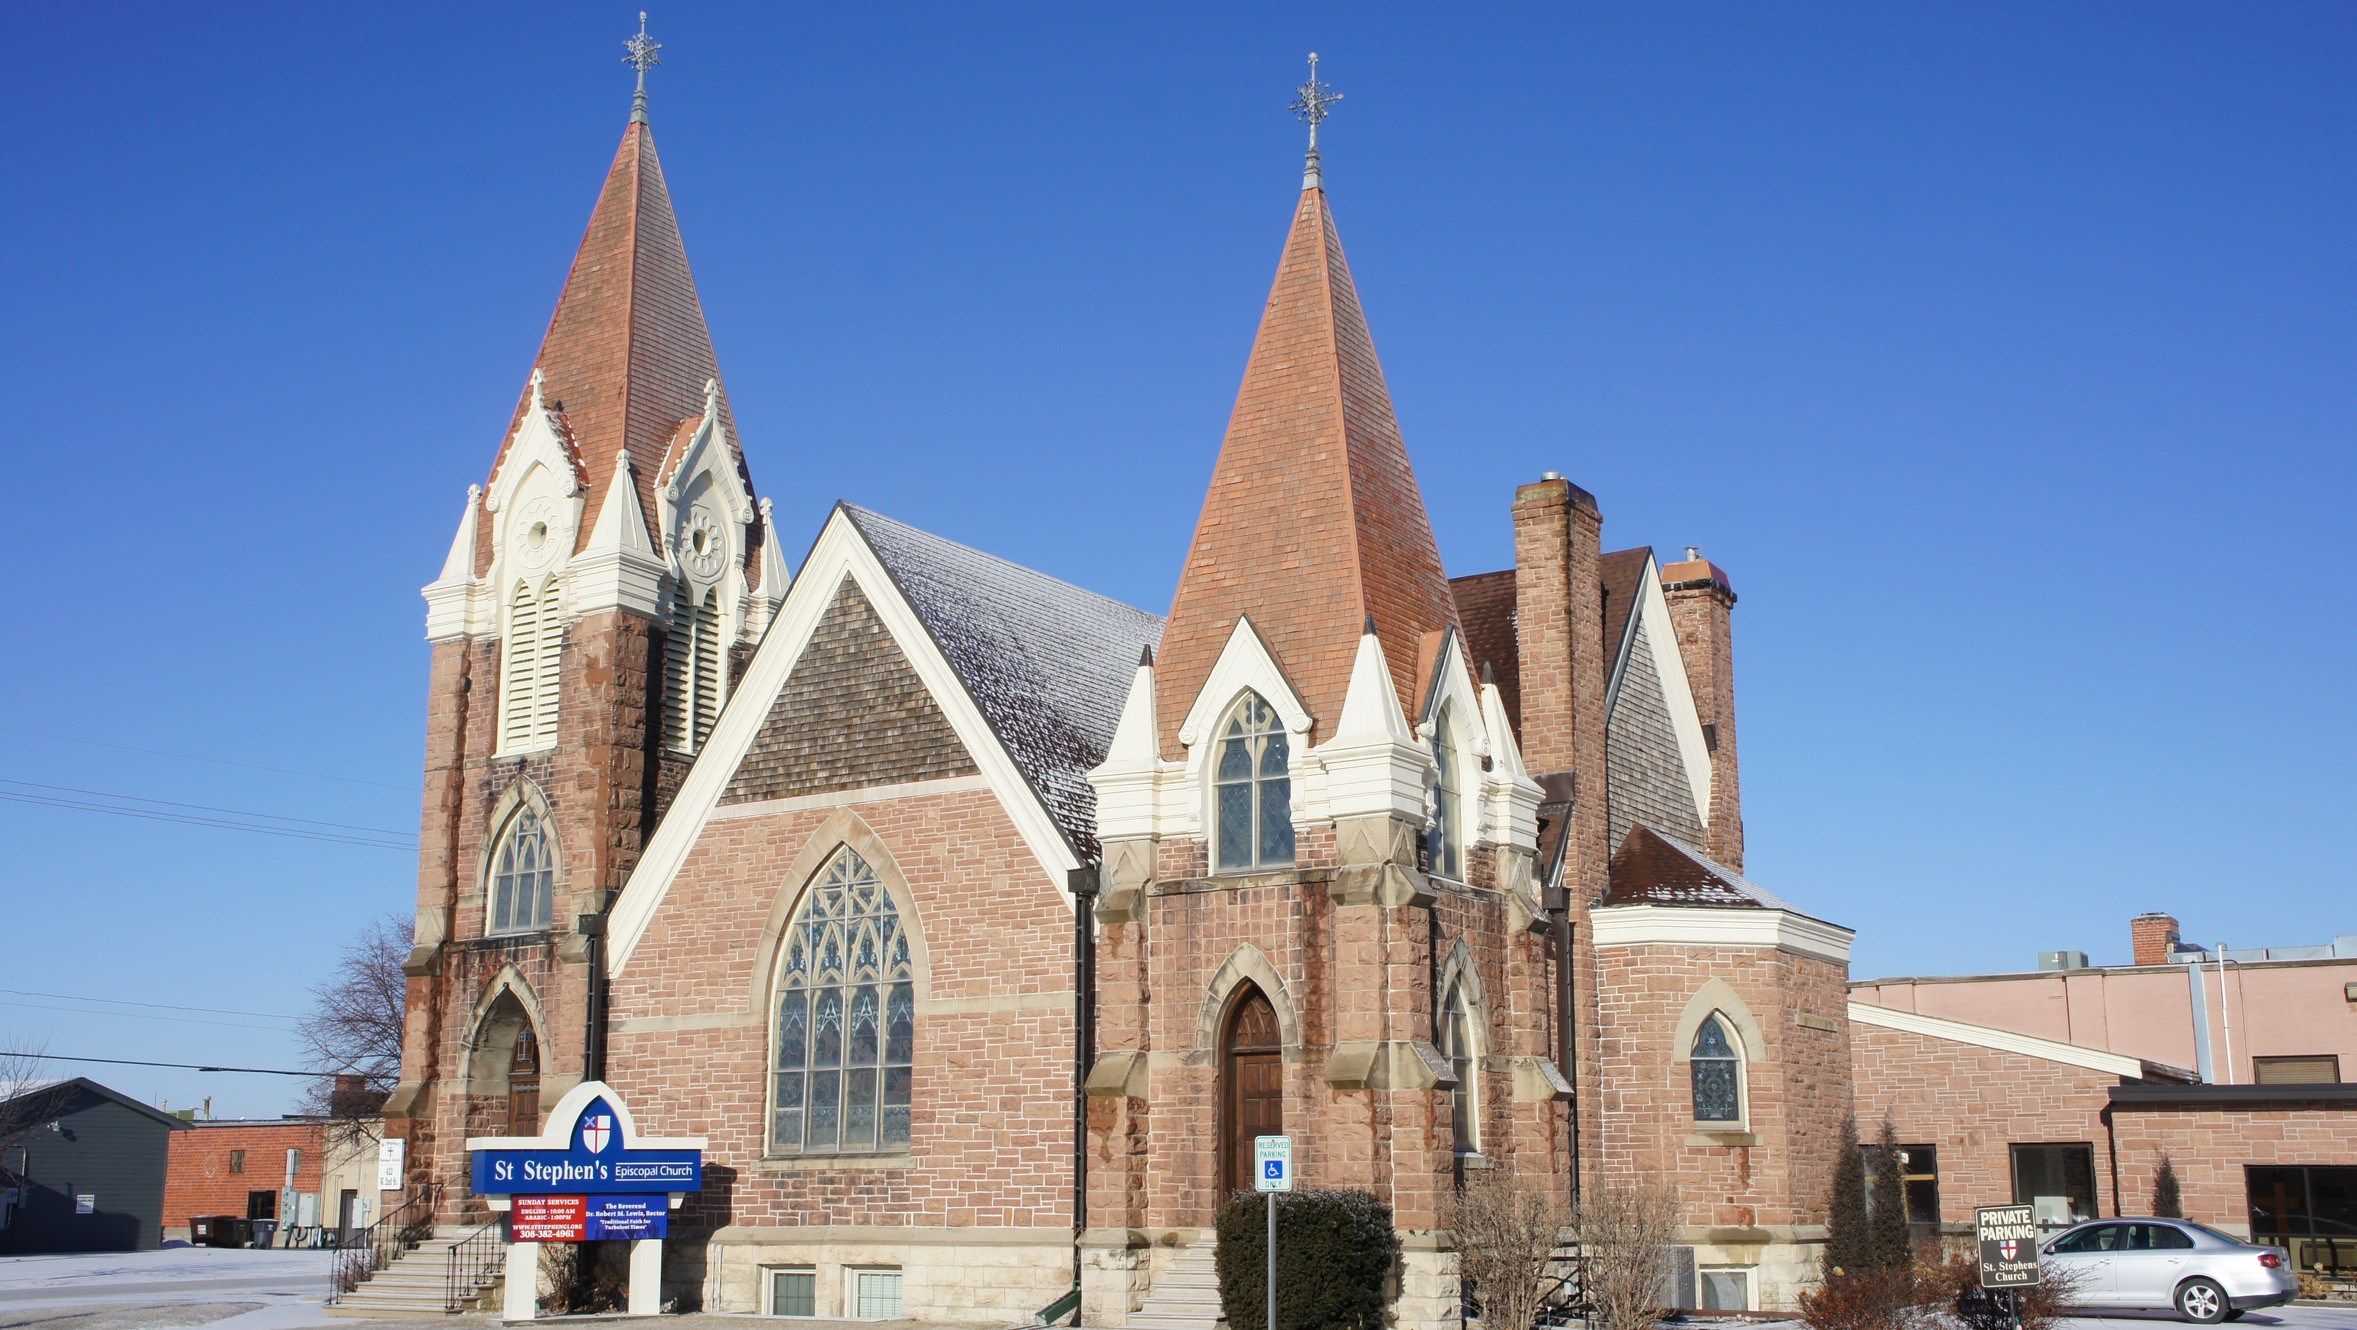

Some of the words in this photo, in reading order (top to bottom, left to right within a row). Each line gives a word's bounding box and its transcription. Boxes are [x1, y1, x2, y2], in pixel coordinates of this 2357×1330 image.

[494, 1160, 514, 1181] St
[524, 1160, 608, 1186] Stephen's
[615, 1165, 658, 1177] Episcopal
[660, 1165, 692, 1176] Church
[1980, 1209, 2031, 1226] PRIVATE
[519, 1230, 575, 1239] 308-382-4961
[1979, 1224, 2035, 1241] PARKING
[1983, 1262, 1996, 1272] St.
[1999, 1260, 2037, 1272] Stephens
[1995, 1271, 2028, 1282] Church
